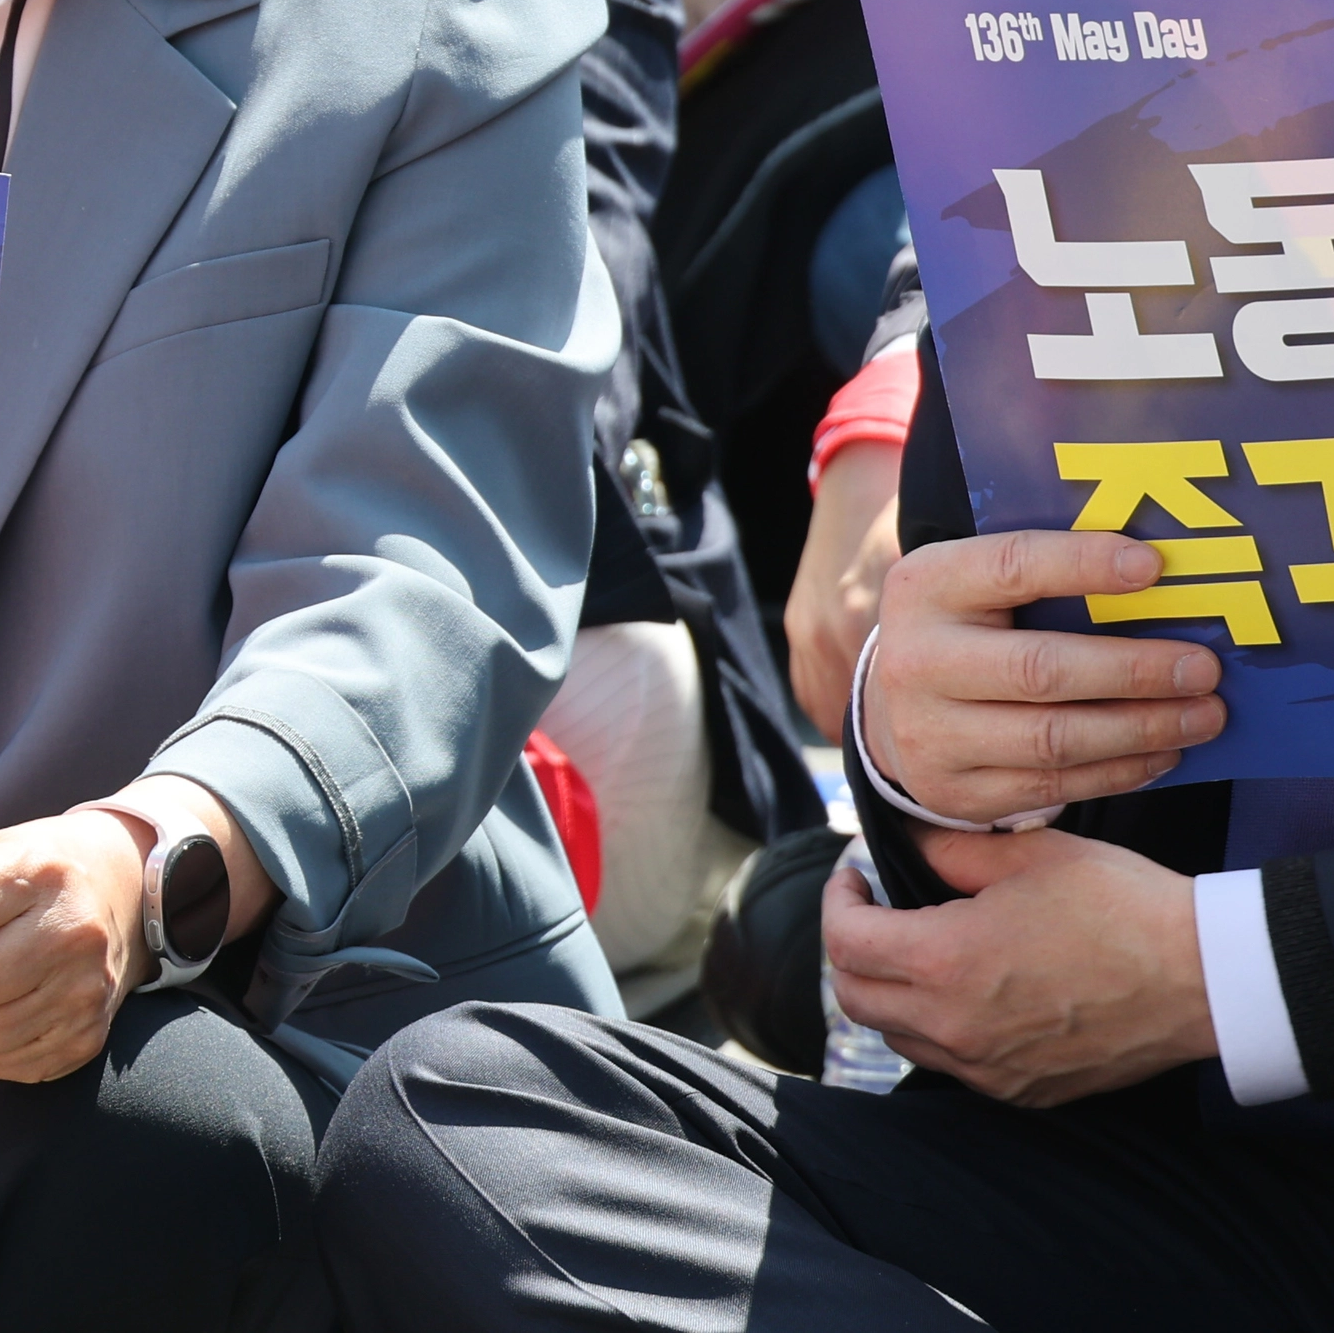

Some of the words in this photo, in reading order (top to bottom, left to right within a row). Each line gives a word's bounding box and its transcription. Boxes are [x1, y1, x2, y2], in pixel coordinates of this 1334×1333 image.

[964, 11, 1044, 62] 136th
[1049, 12, 1130, 62] May
[1133, 10, 1208, 61] Day
